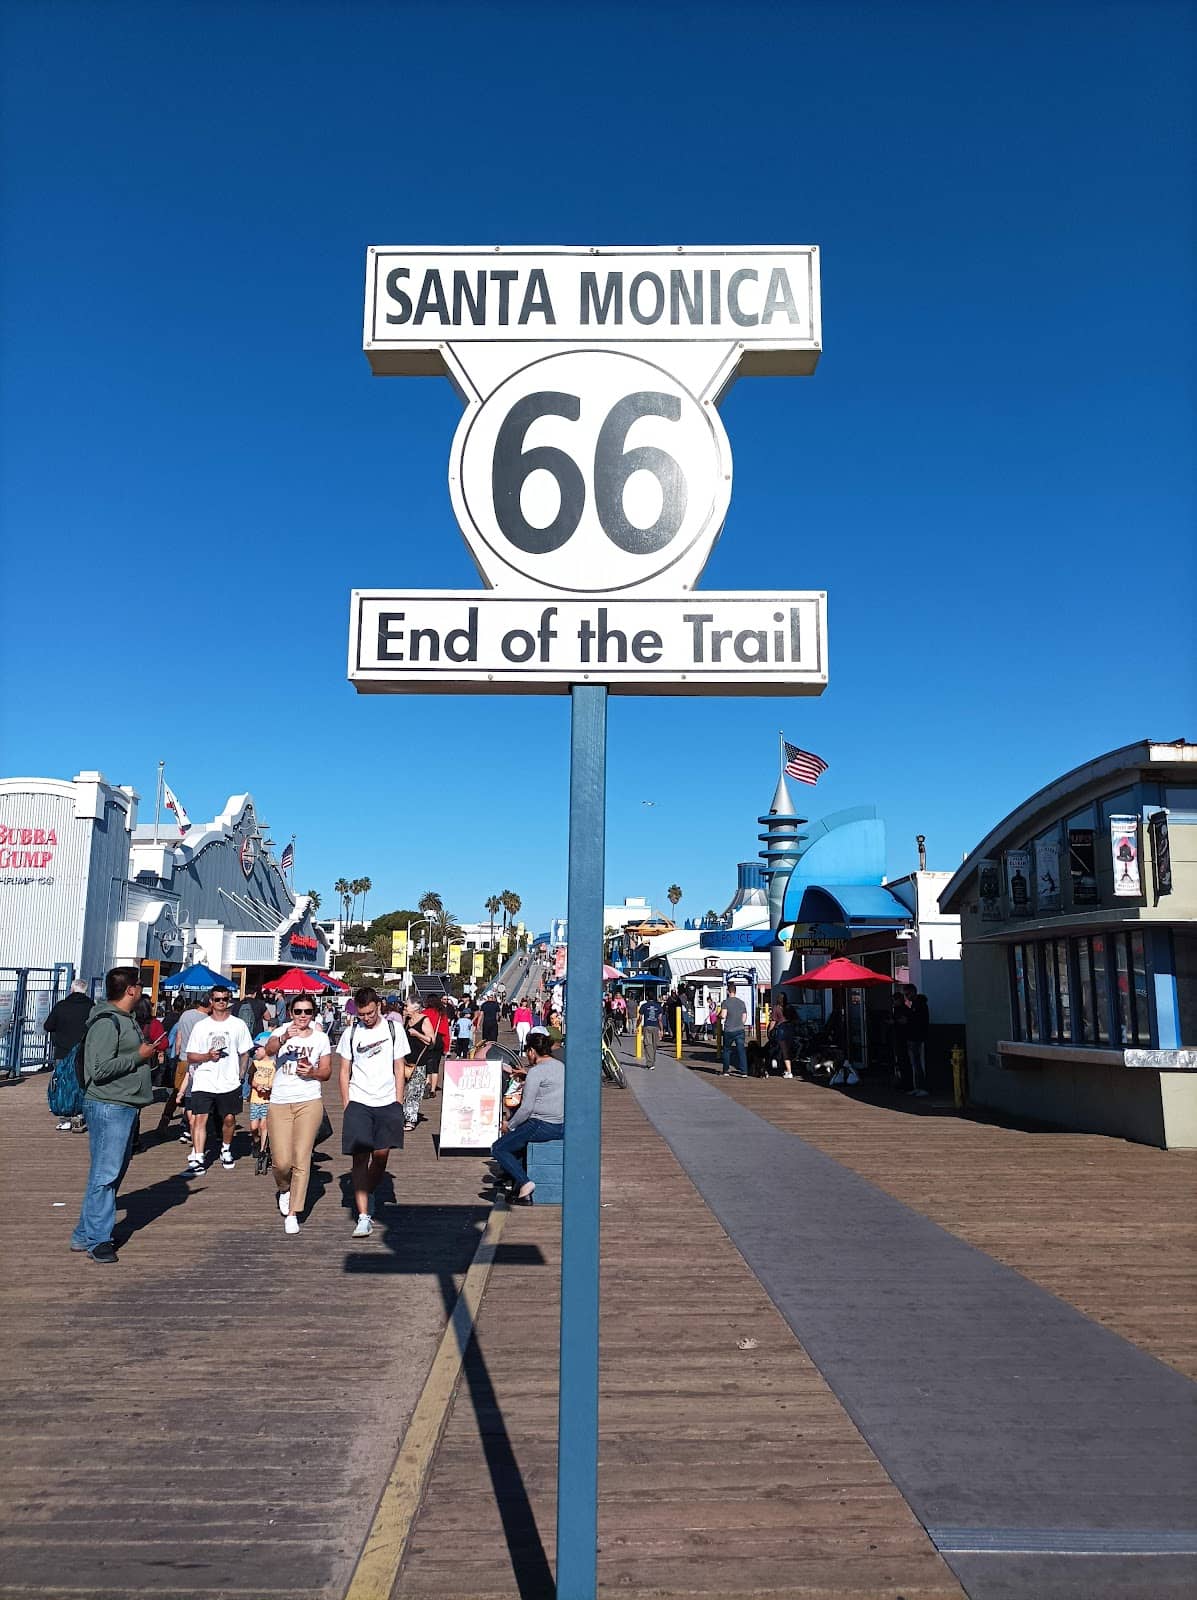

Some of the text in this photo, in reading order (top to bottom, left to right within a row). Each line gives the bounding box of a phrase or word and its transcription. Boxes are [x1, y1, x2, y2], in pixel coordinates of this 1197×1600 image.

[385, 267, 801, 327] SANTA MONICA
[492, 390, 688, 554] 66
[376, 607, 801, 663] End of the Trail
[286, 1044, 315, 1058] STAY
